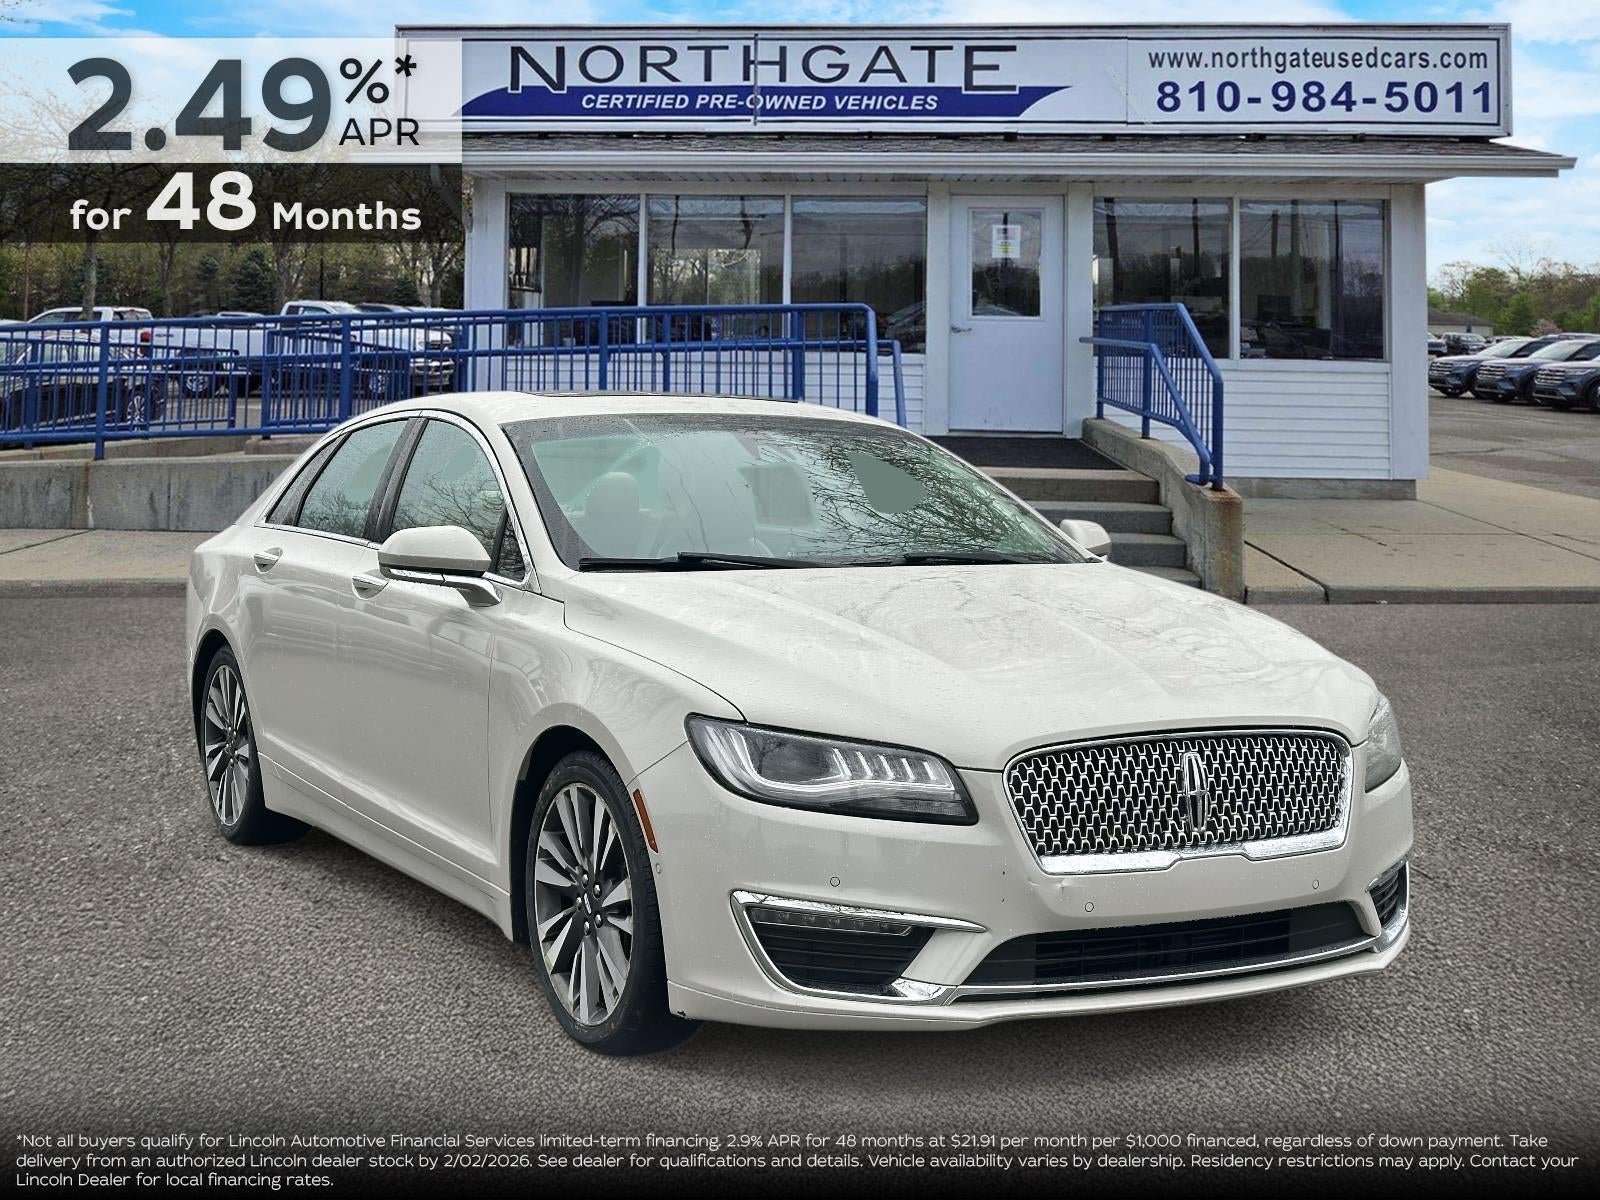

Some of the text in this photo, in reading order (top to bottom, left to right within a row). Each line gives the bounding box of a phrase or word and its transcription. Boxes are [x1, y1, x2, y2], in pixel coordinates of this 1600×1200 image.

[510, 44, 1017, 92] NORTHGATE
[1149, 46, 1488, 73] www.northgateusedcars.com
[581, 94, 938, 110] CERTIFIED PRE-OWNED VEHICLES
[1156, 80, 1491, 113] 810-984-5011
